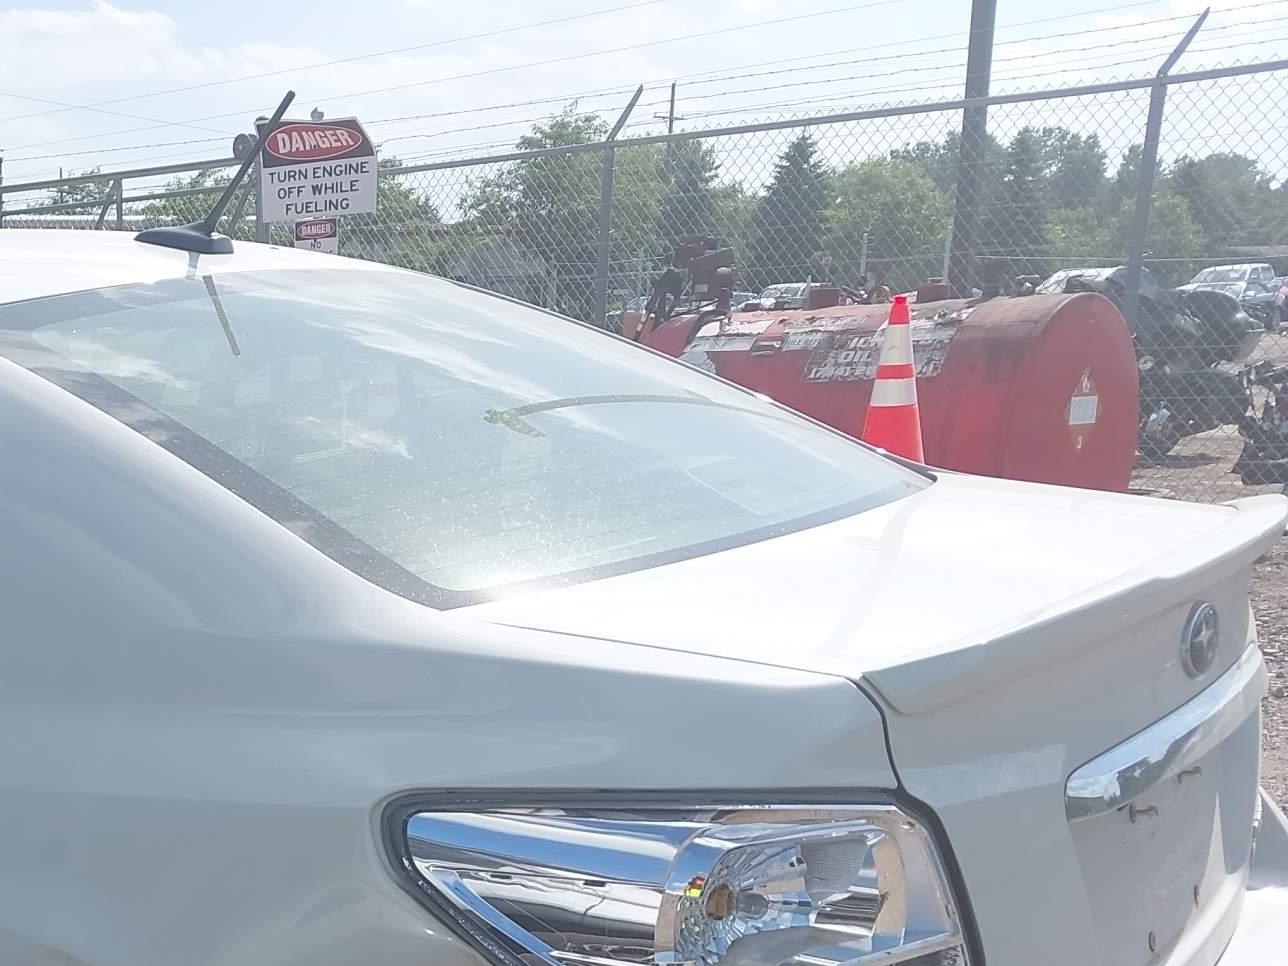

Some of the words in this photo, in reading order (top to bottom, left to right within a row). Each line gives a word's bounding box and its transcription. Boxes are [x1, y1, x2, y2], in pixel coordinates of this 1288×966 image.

[277, 129, 355, 154] DANGER
[268, 169, 308, 184] TURN
[312, 161, 369, 178] ENGINE
[277, 186, 306, 200] OFF
[312, 179, 359, 196] WHILE
[285, 197, 350, 215] FUELING
[302, 223, 331, 236] DANGER
[310, 240, 321, 249] NO
